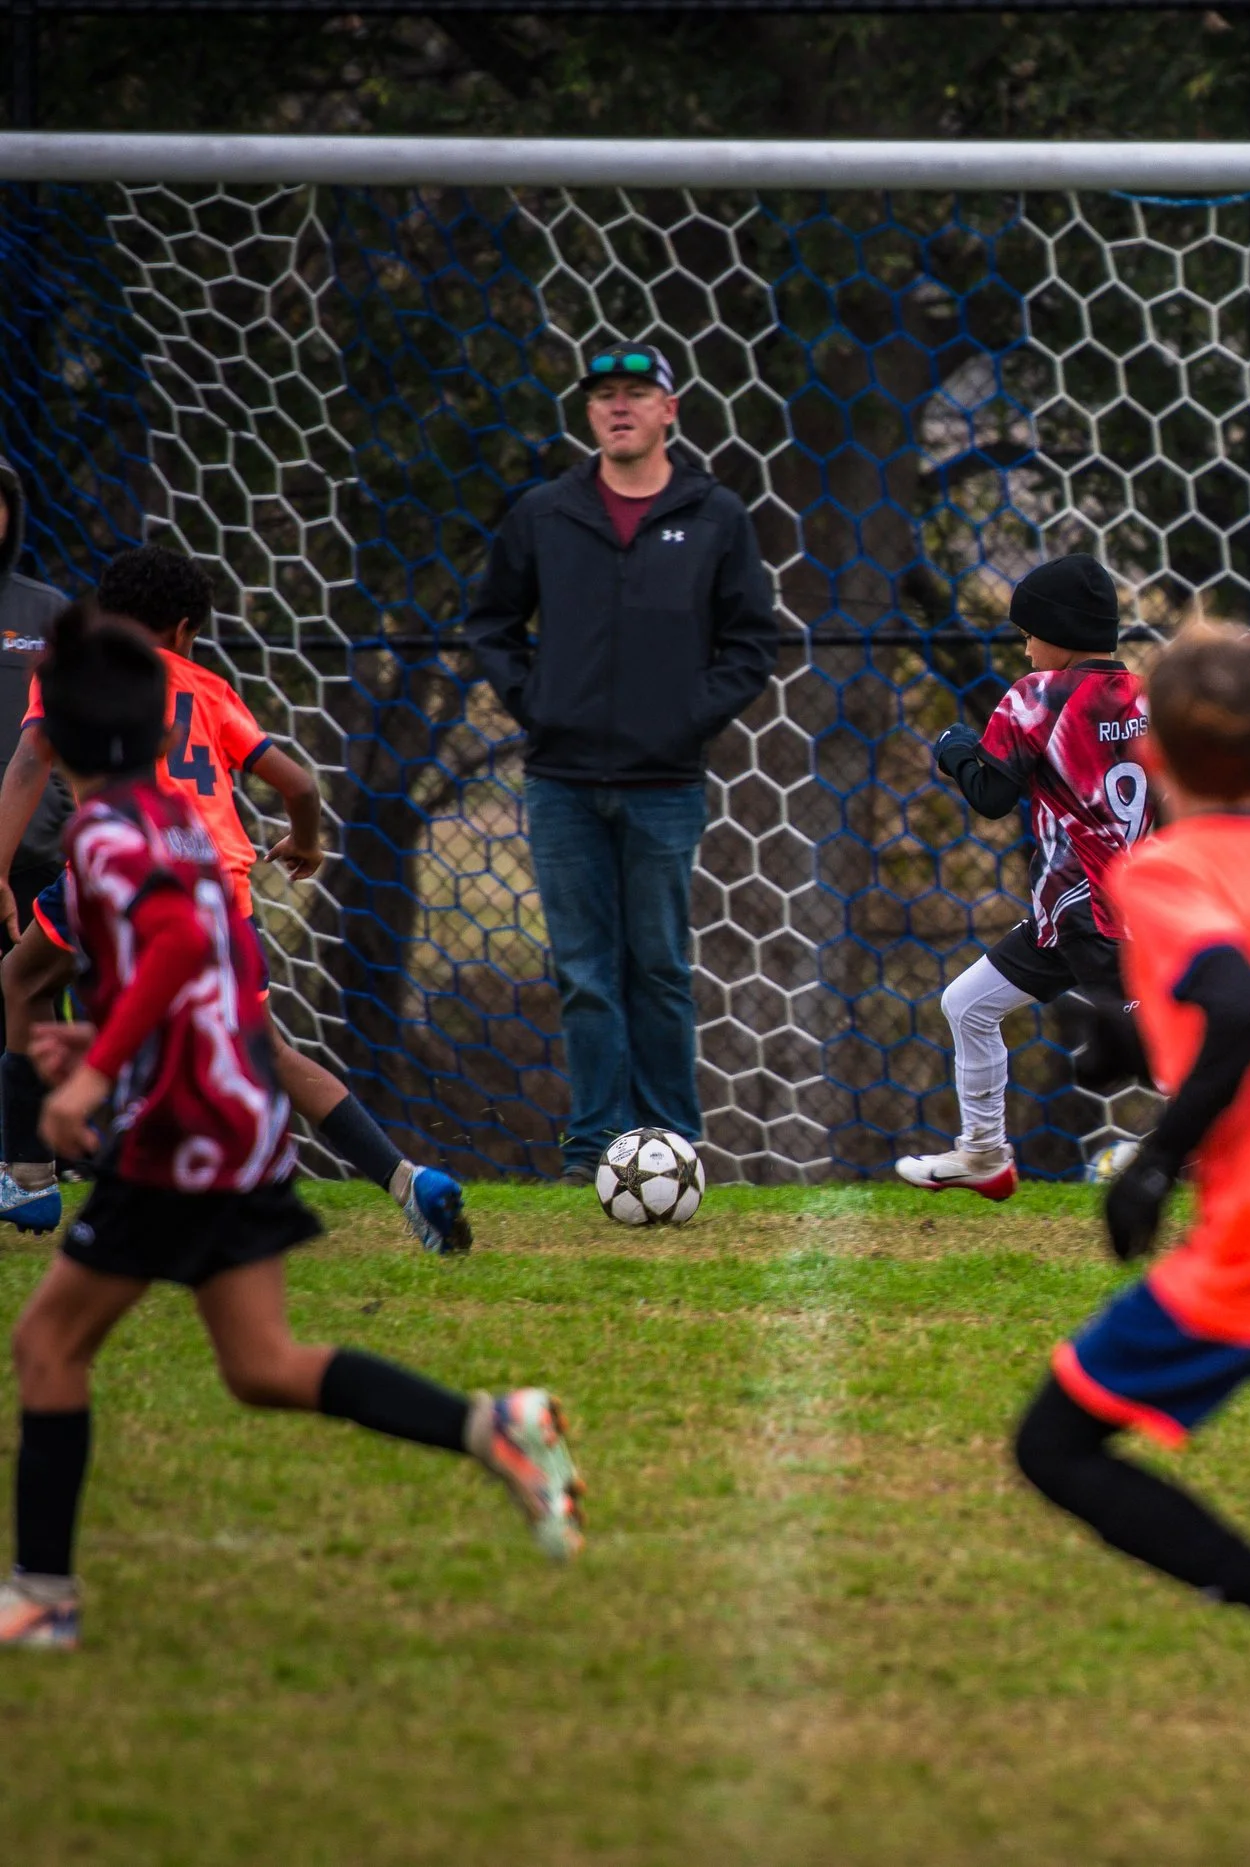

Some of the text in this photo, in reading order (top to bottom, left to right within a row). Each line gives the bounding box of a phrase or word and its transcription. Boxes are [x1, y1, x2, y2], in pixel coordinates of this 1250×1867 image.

[167, 692, 216, 796] 4
[1099, 716, 1149, 742] ROJAS
[1104, 760, 1148, 847] 9
